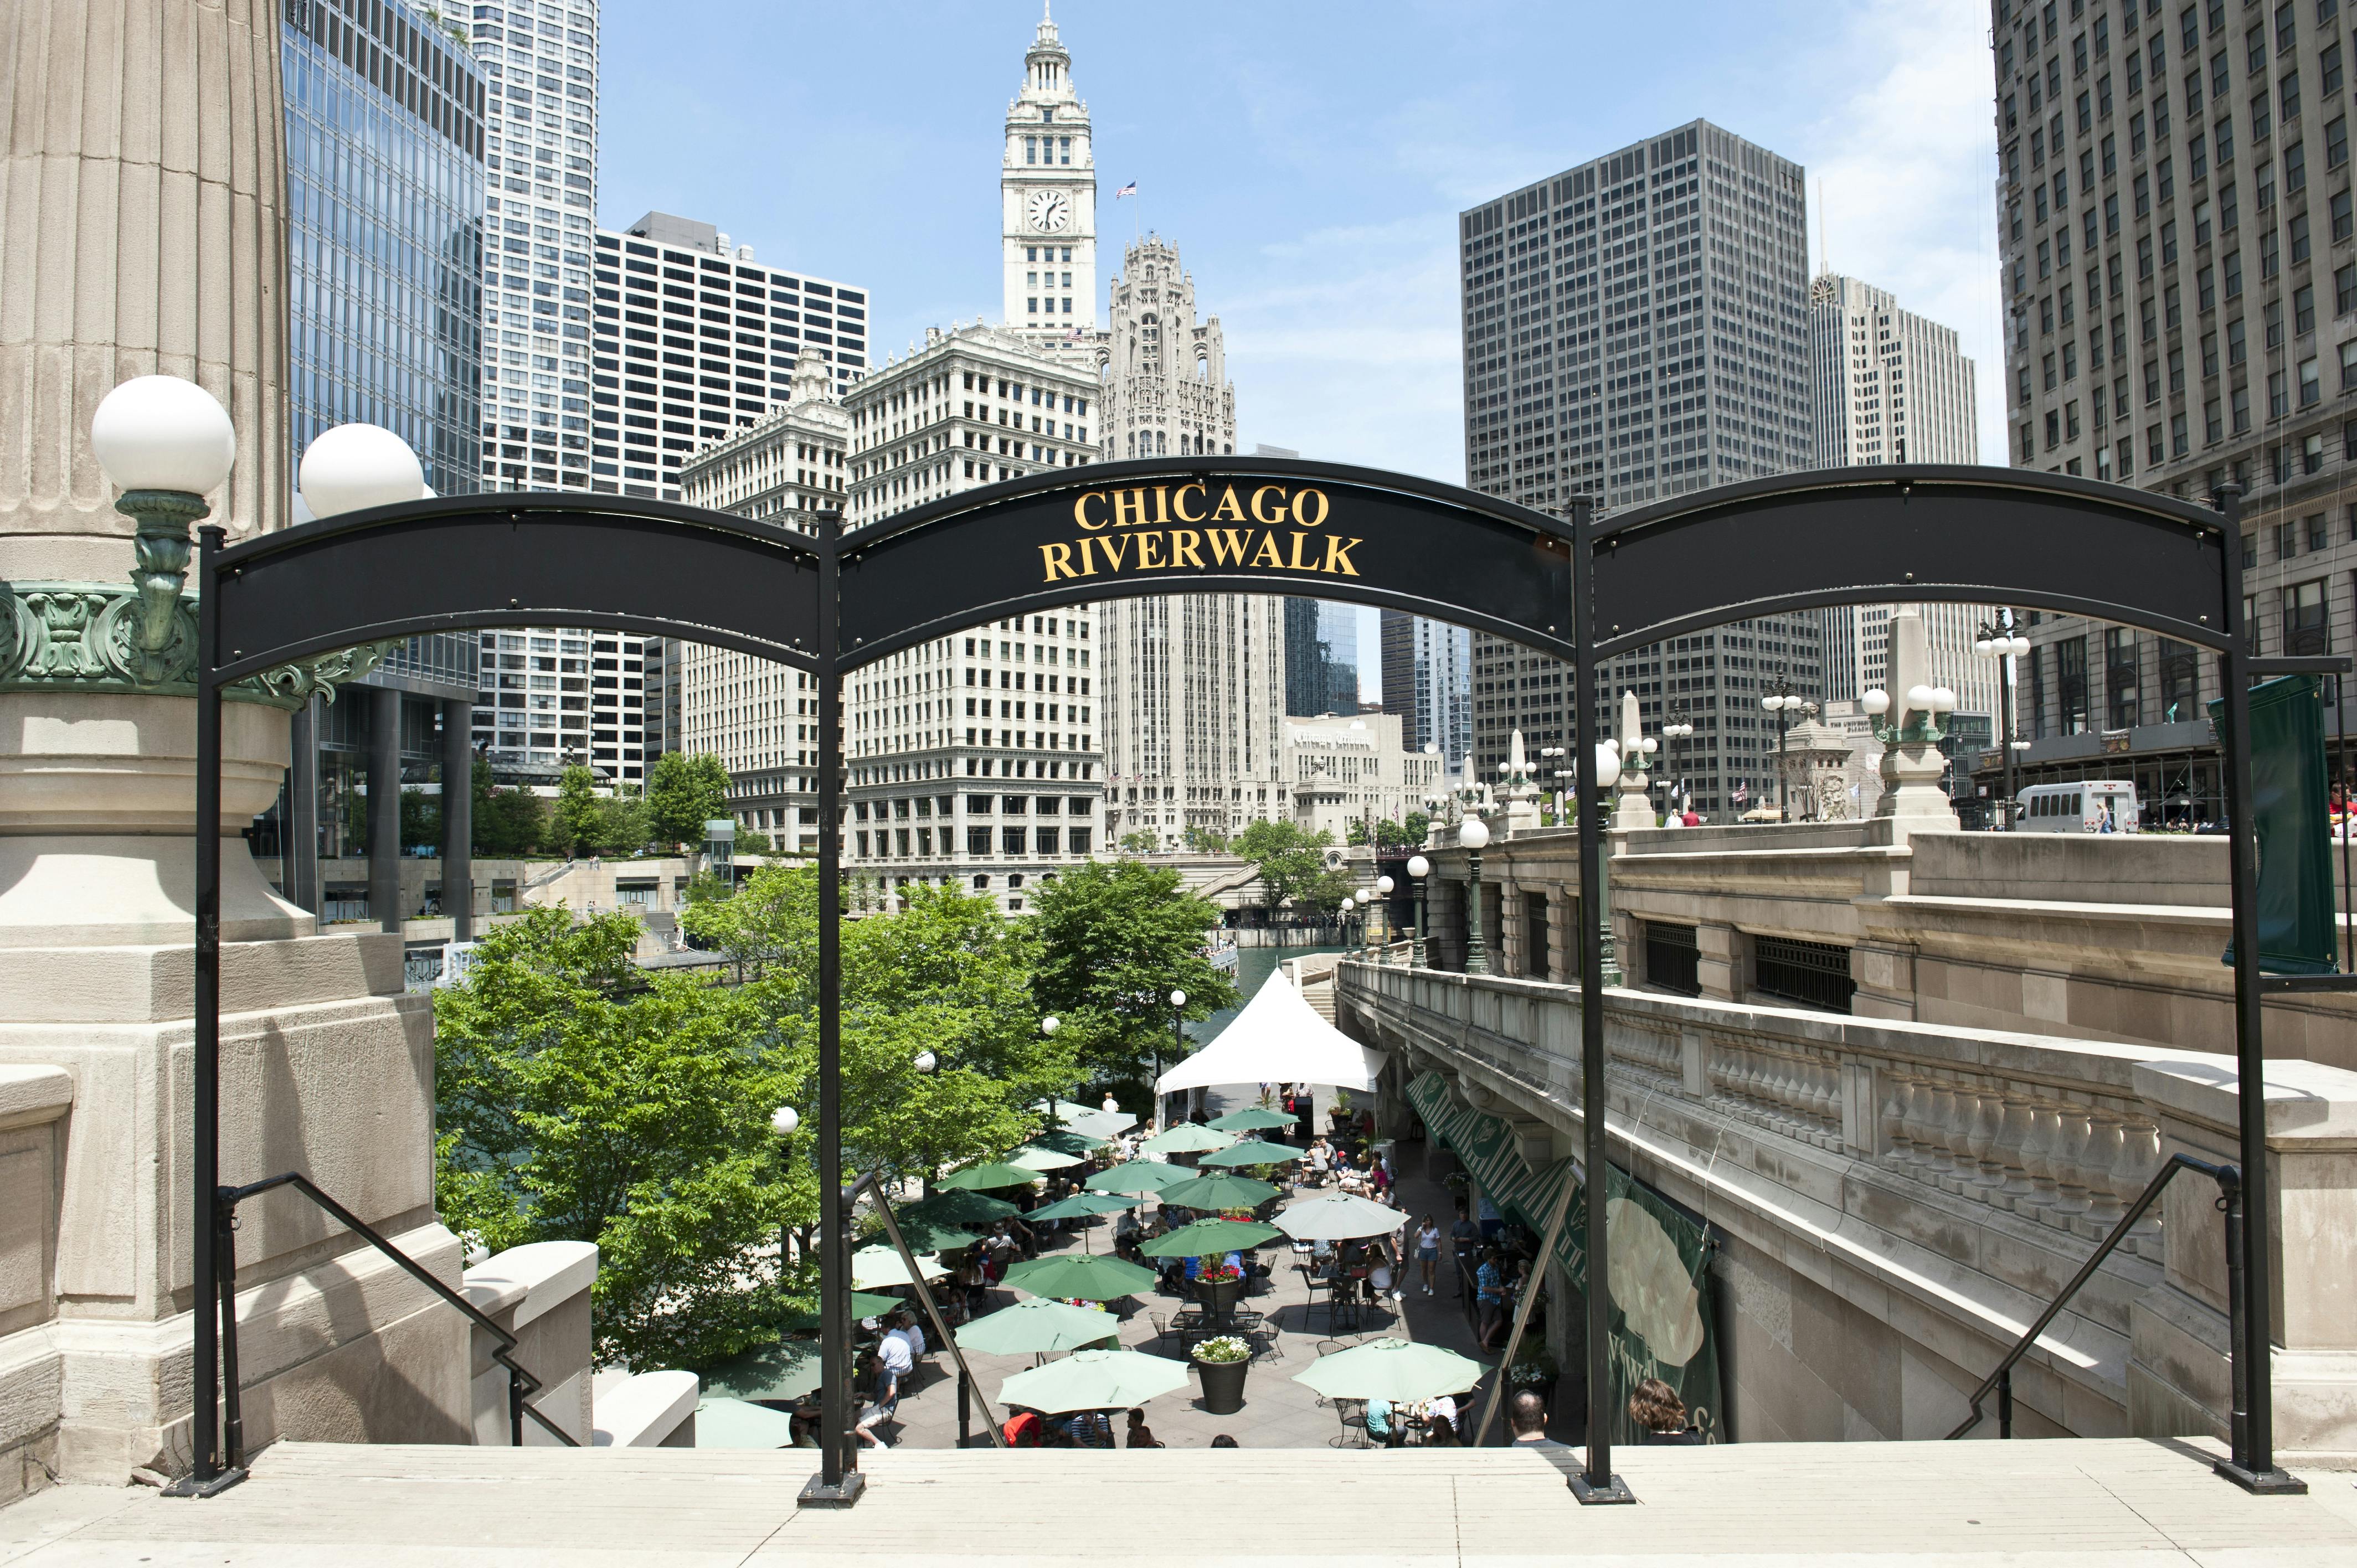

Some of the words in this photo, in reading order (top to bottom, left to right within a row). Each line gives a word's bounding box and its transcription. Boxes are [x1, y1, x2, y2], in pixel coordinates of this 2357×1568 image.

[1074, 483, 1328, 530] CHICAGO
[1038, 529, 1363, 582] RIVERWALK
[1294, 729, 1331, 746] Chicago
[1336, 731, 1370, 746] Tribune
